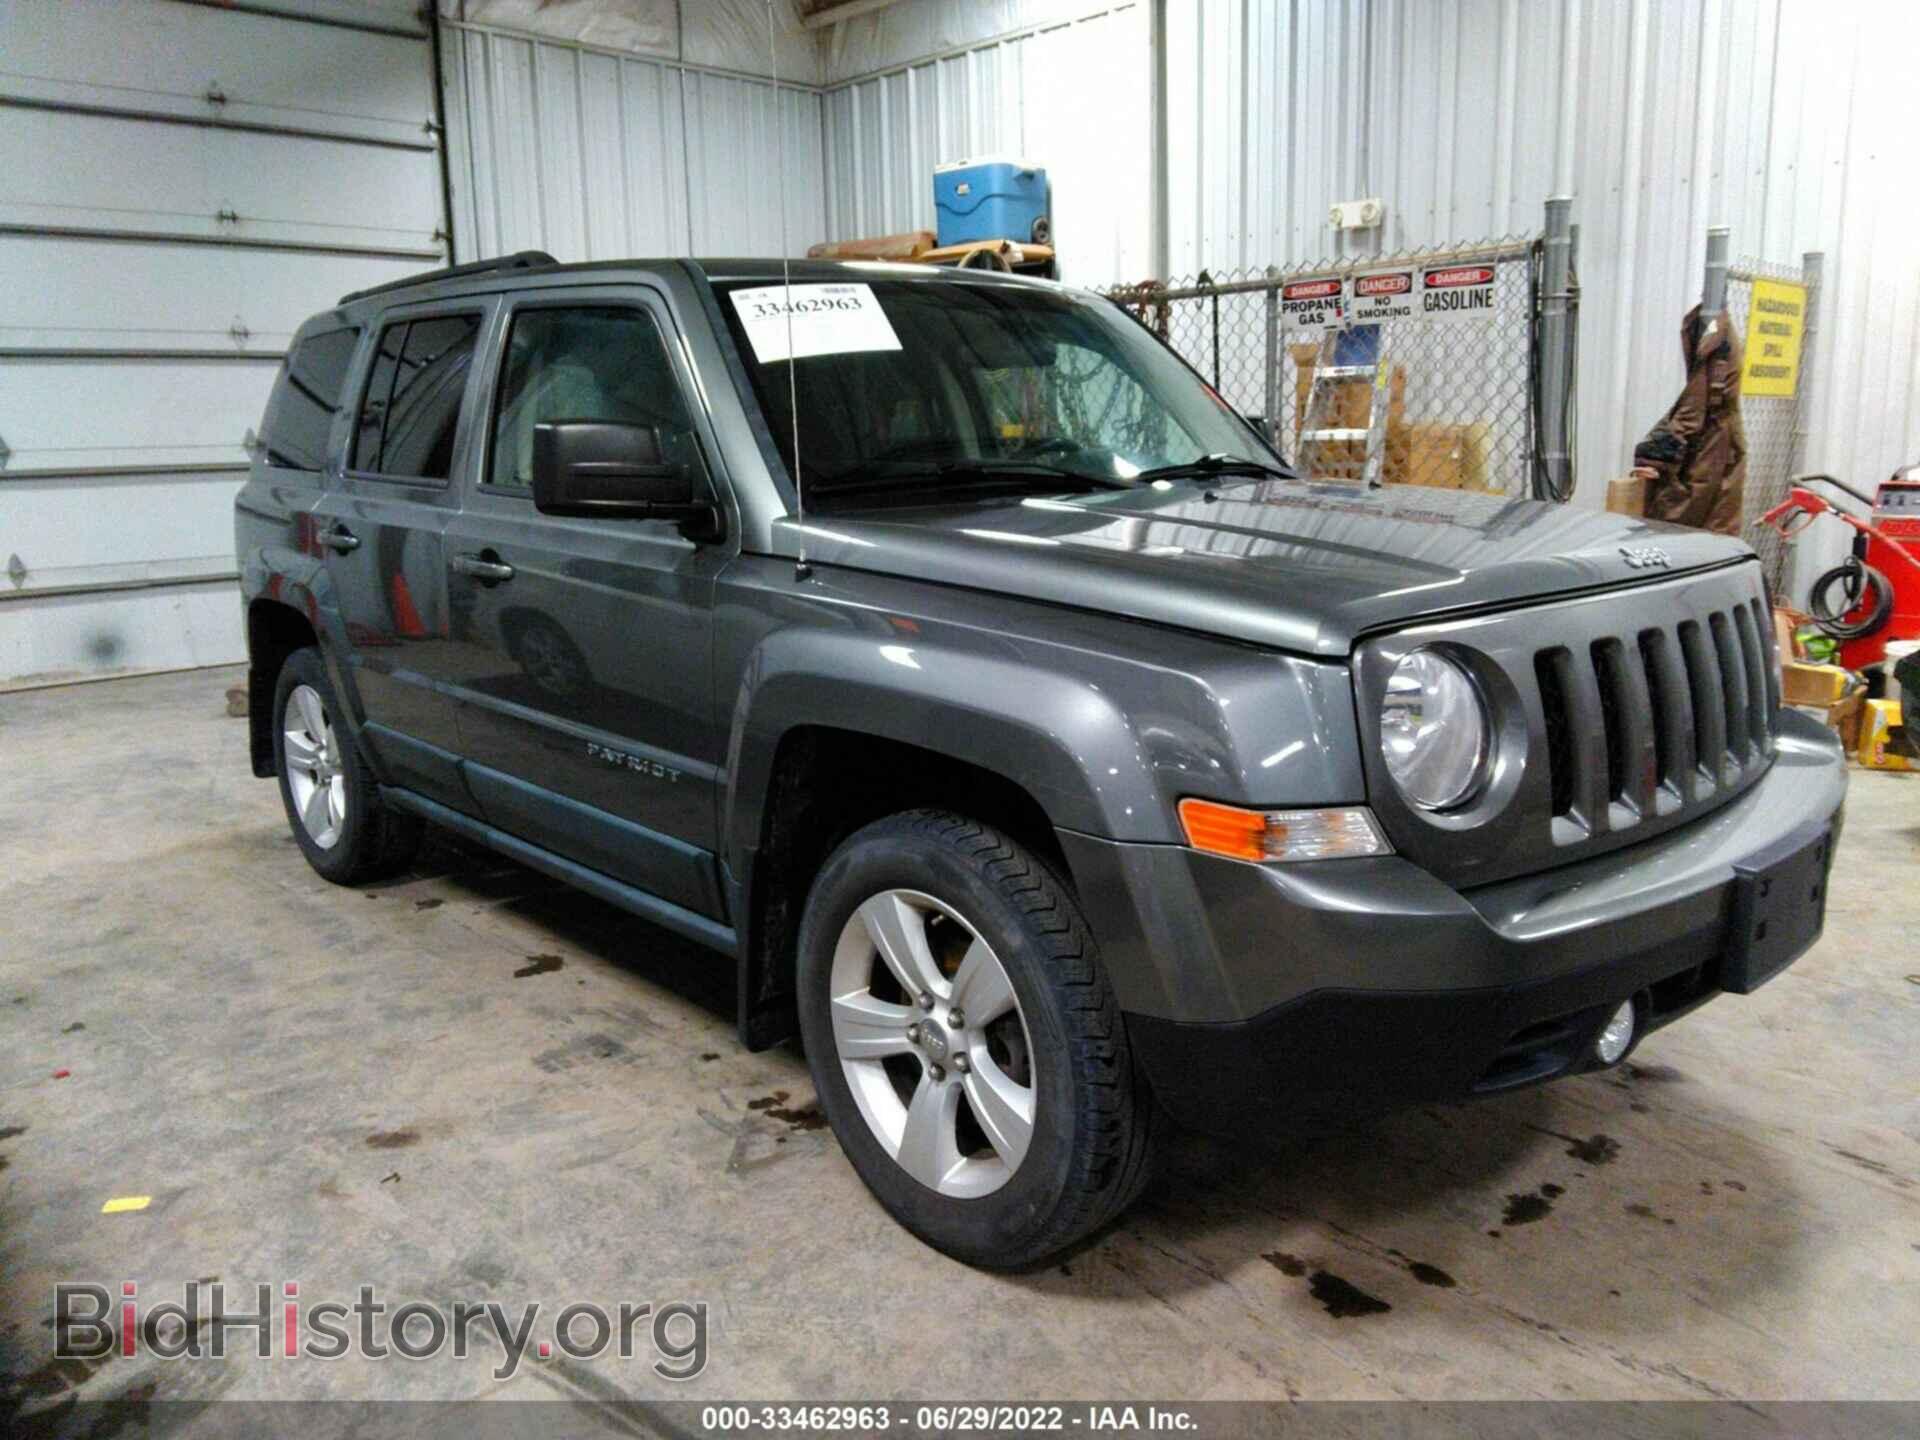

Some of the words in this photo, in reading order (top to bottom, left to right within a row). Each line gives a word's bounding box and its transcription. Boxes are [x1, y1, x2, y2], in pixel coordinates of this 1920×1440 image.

[1435, 270, 1481, 284] DANGER
[1291, 282, 1332, 297] DANGER
[1359, 277, 1408, 293] DANGER
[752, 297, 862, 318] 33462963
[1282, 298, 1342, 313] PROPANE
[1374, 296, 1391, 306] NO
[1423, 291, 1493, 312] GASOLINE
[1298, 312, 1325, 326] GAS
[1356, 306, 1411, 319] SMOKING
[586, 742, 681, 783] PATRIOT
